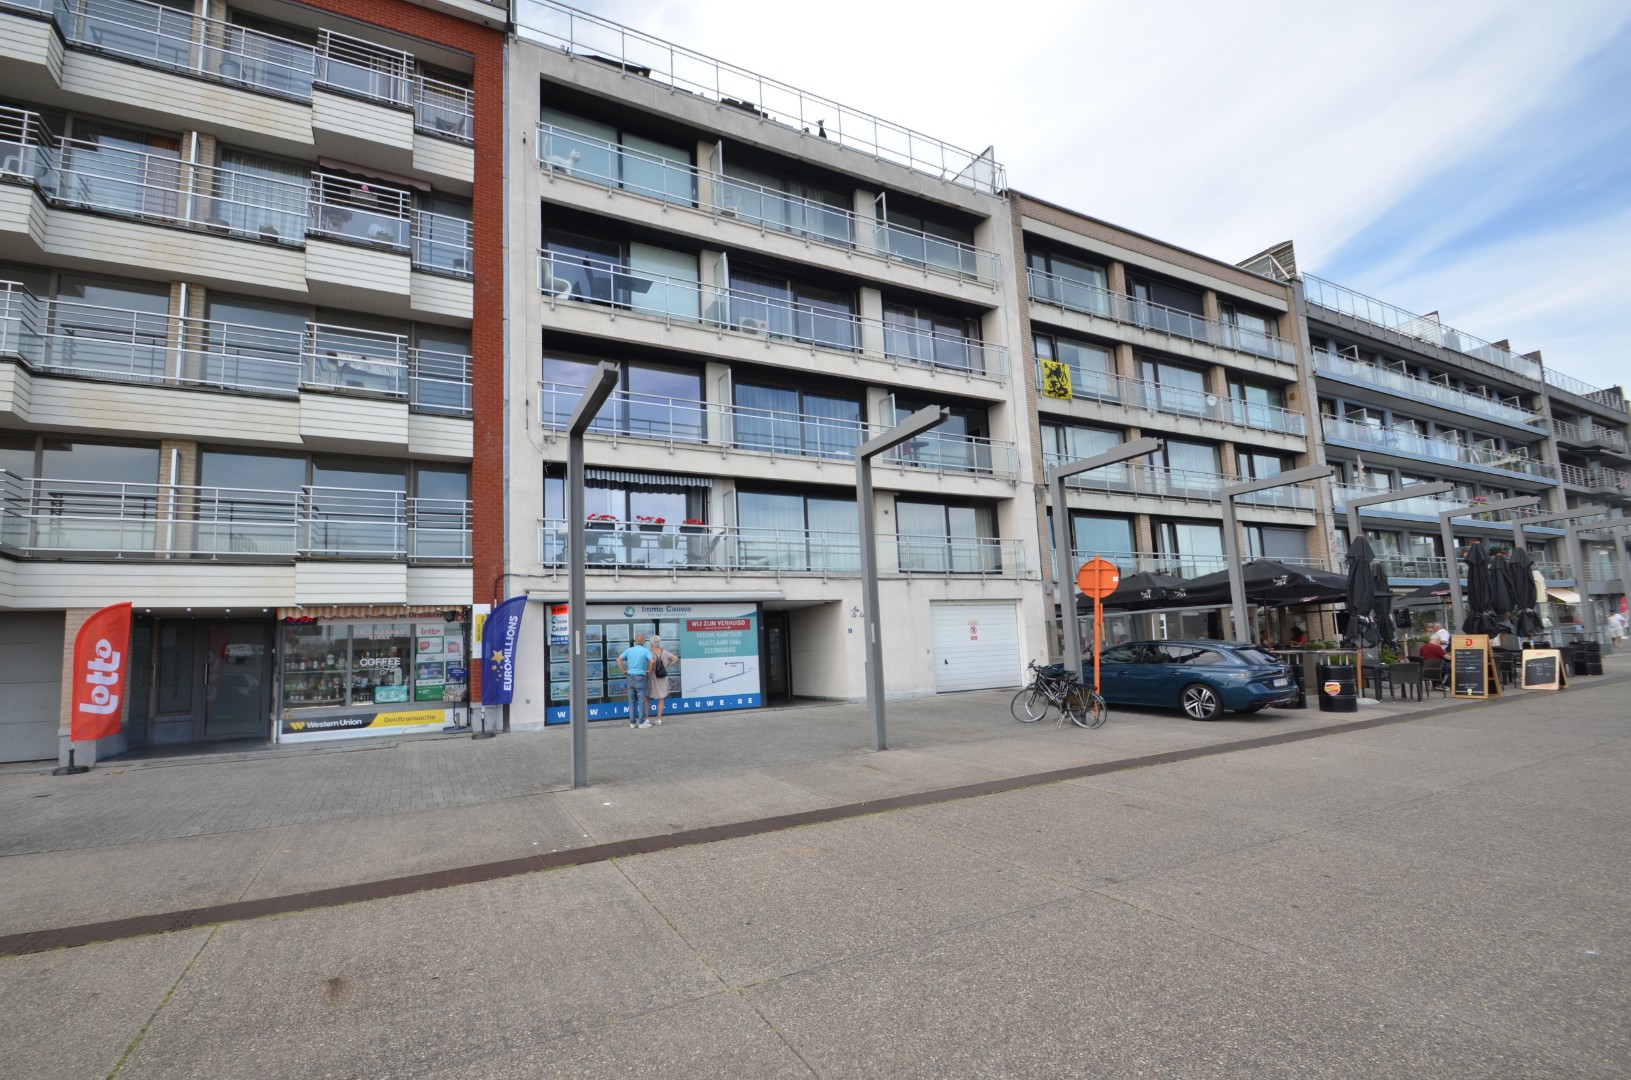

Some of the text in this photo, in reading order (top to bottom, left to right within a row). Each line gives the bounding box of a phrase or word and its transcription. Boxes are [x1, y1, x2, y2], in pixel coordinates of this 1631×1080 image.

[641, 605, 692, 613] Immo Cauwe
[503, 615, 519, 691] EUROMILLIONS
[359, 657, 401, 667] COFFEE
[306, 713, 436, 729] Western Union Geldtransactie
